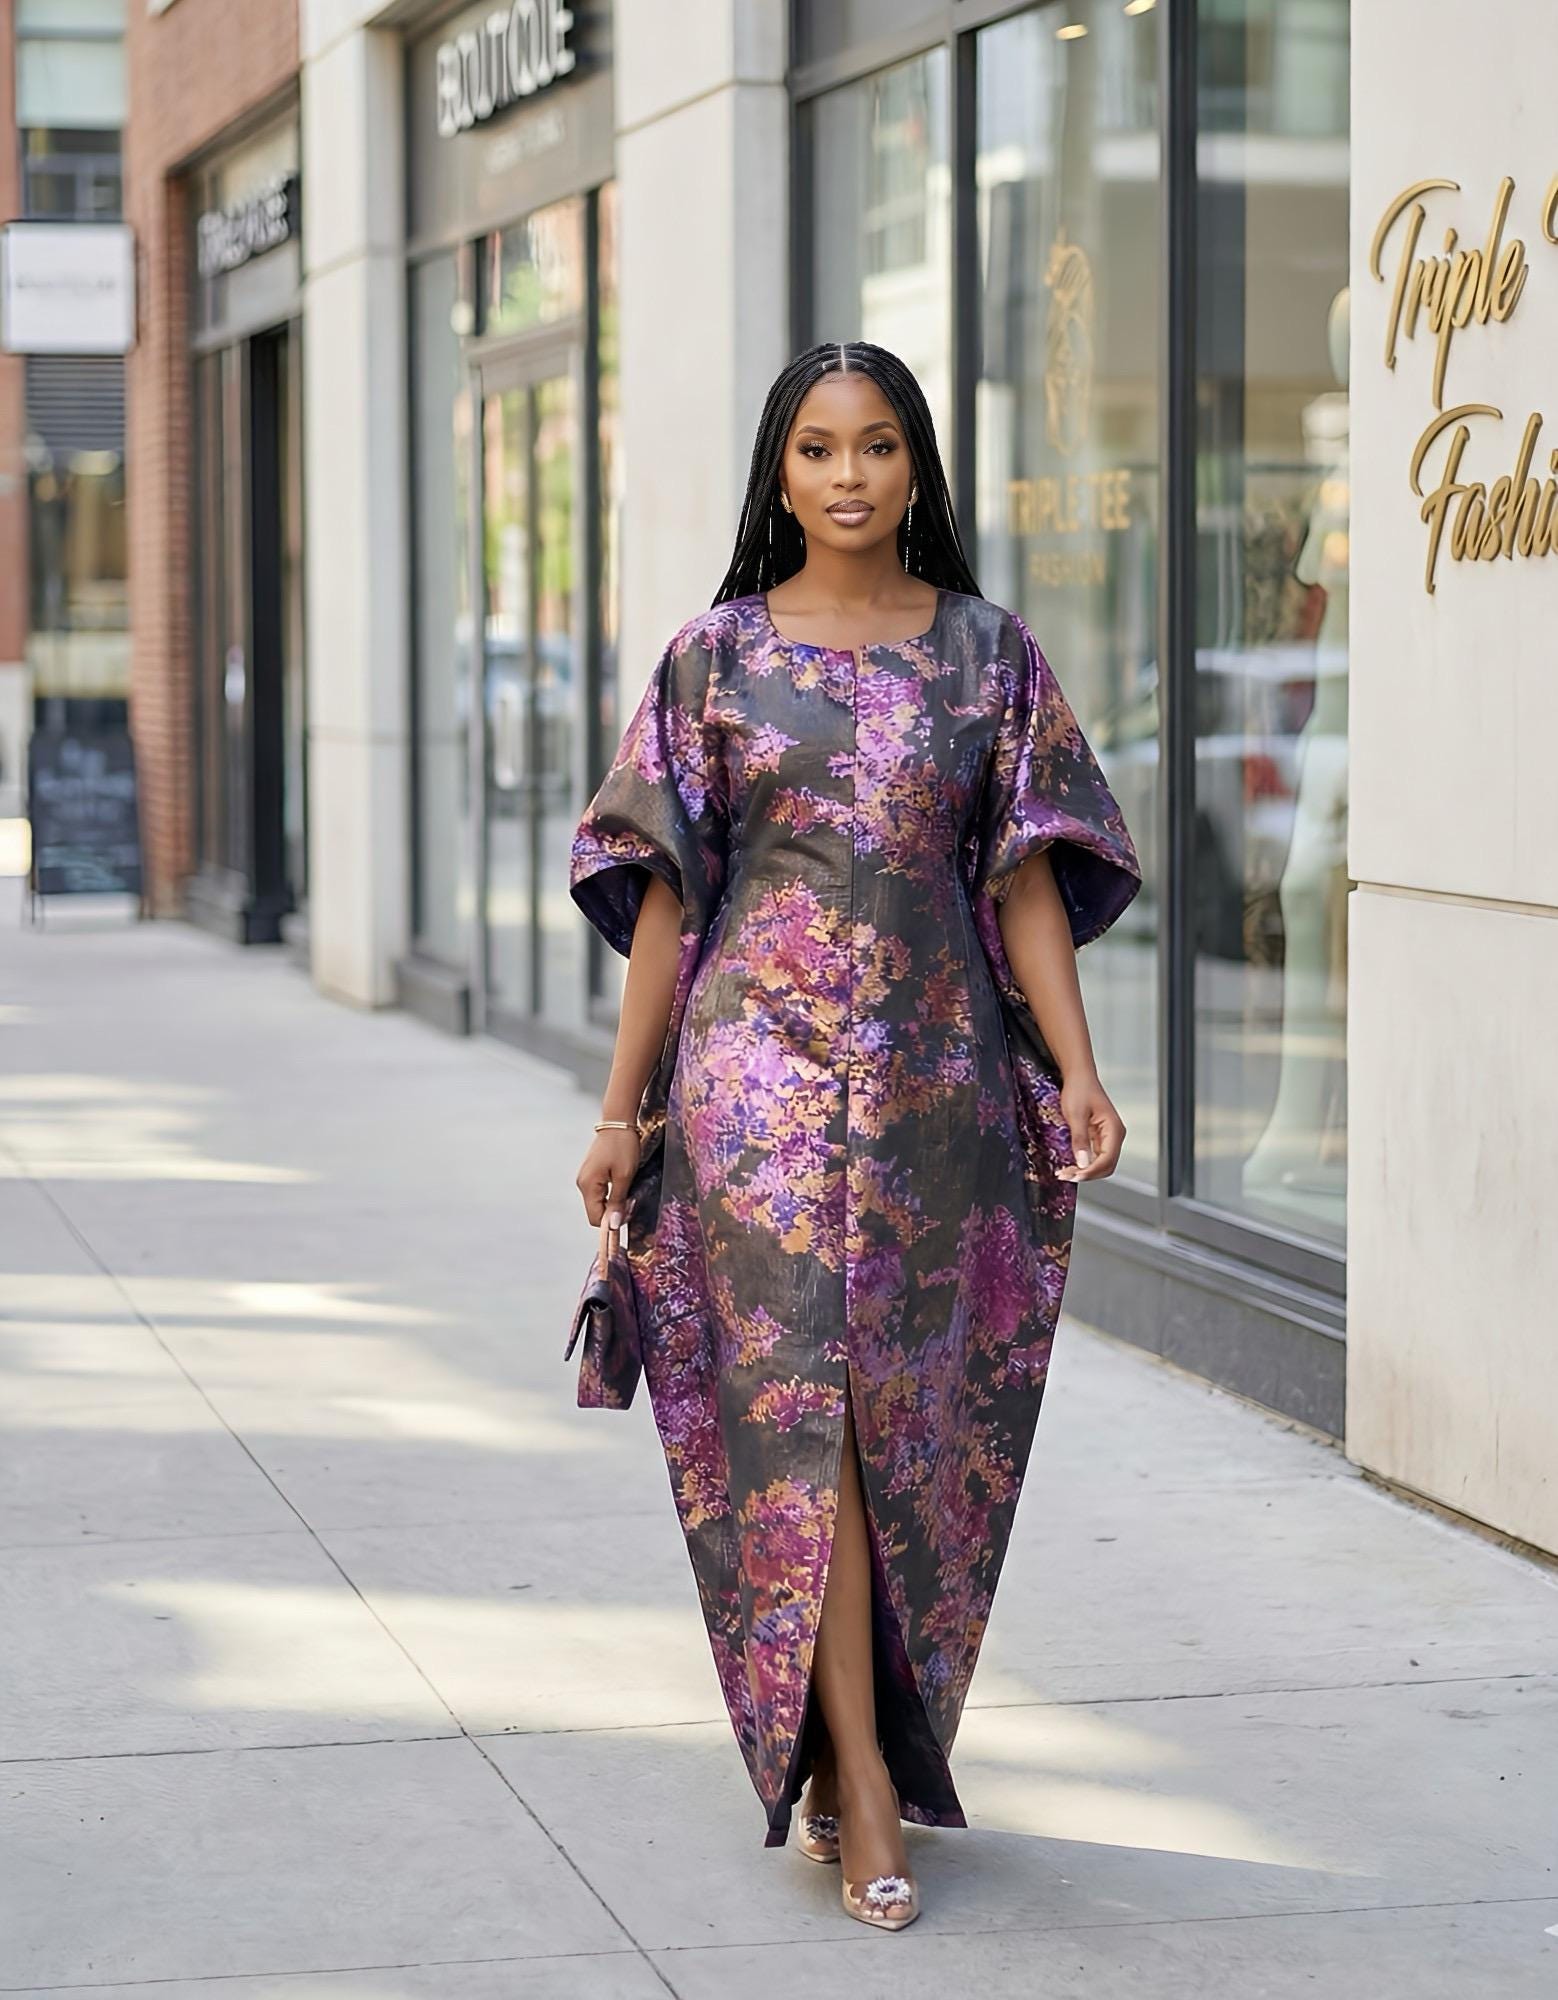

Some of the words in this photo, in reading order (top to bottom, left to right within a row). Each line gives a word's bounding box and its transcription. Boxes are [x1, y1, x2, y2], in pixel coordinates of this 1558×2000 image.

[1370, 176, 1528, 411] Triple
[1007, 474, 1081, 536] TRIPLE
[1087, 468, 1131, 531] TEE
[1409, 403, 1558, 595] Fashi
